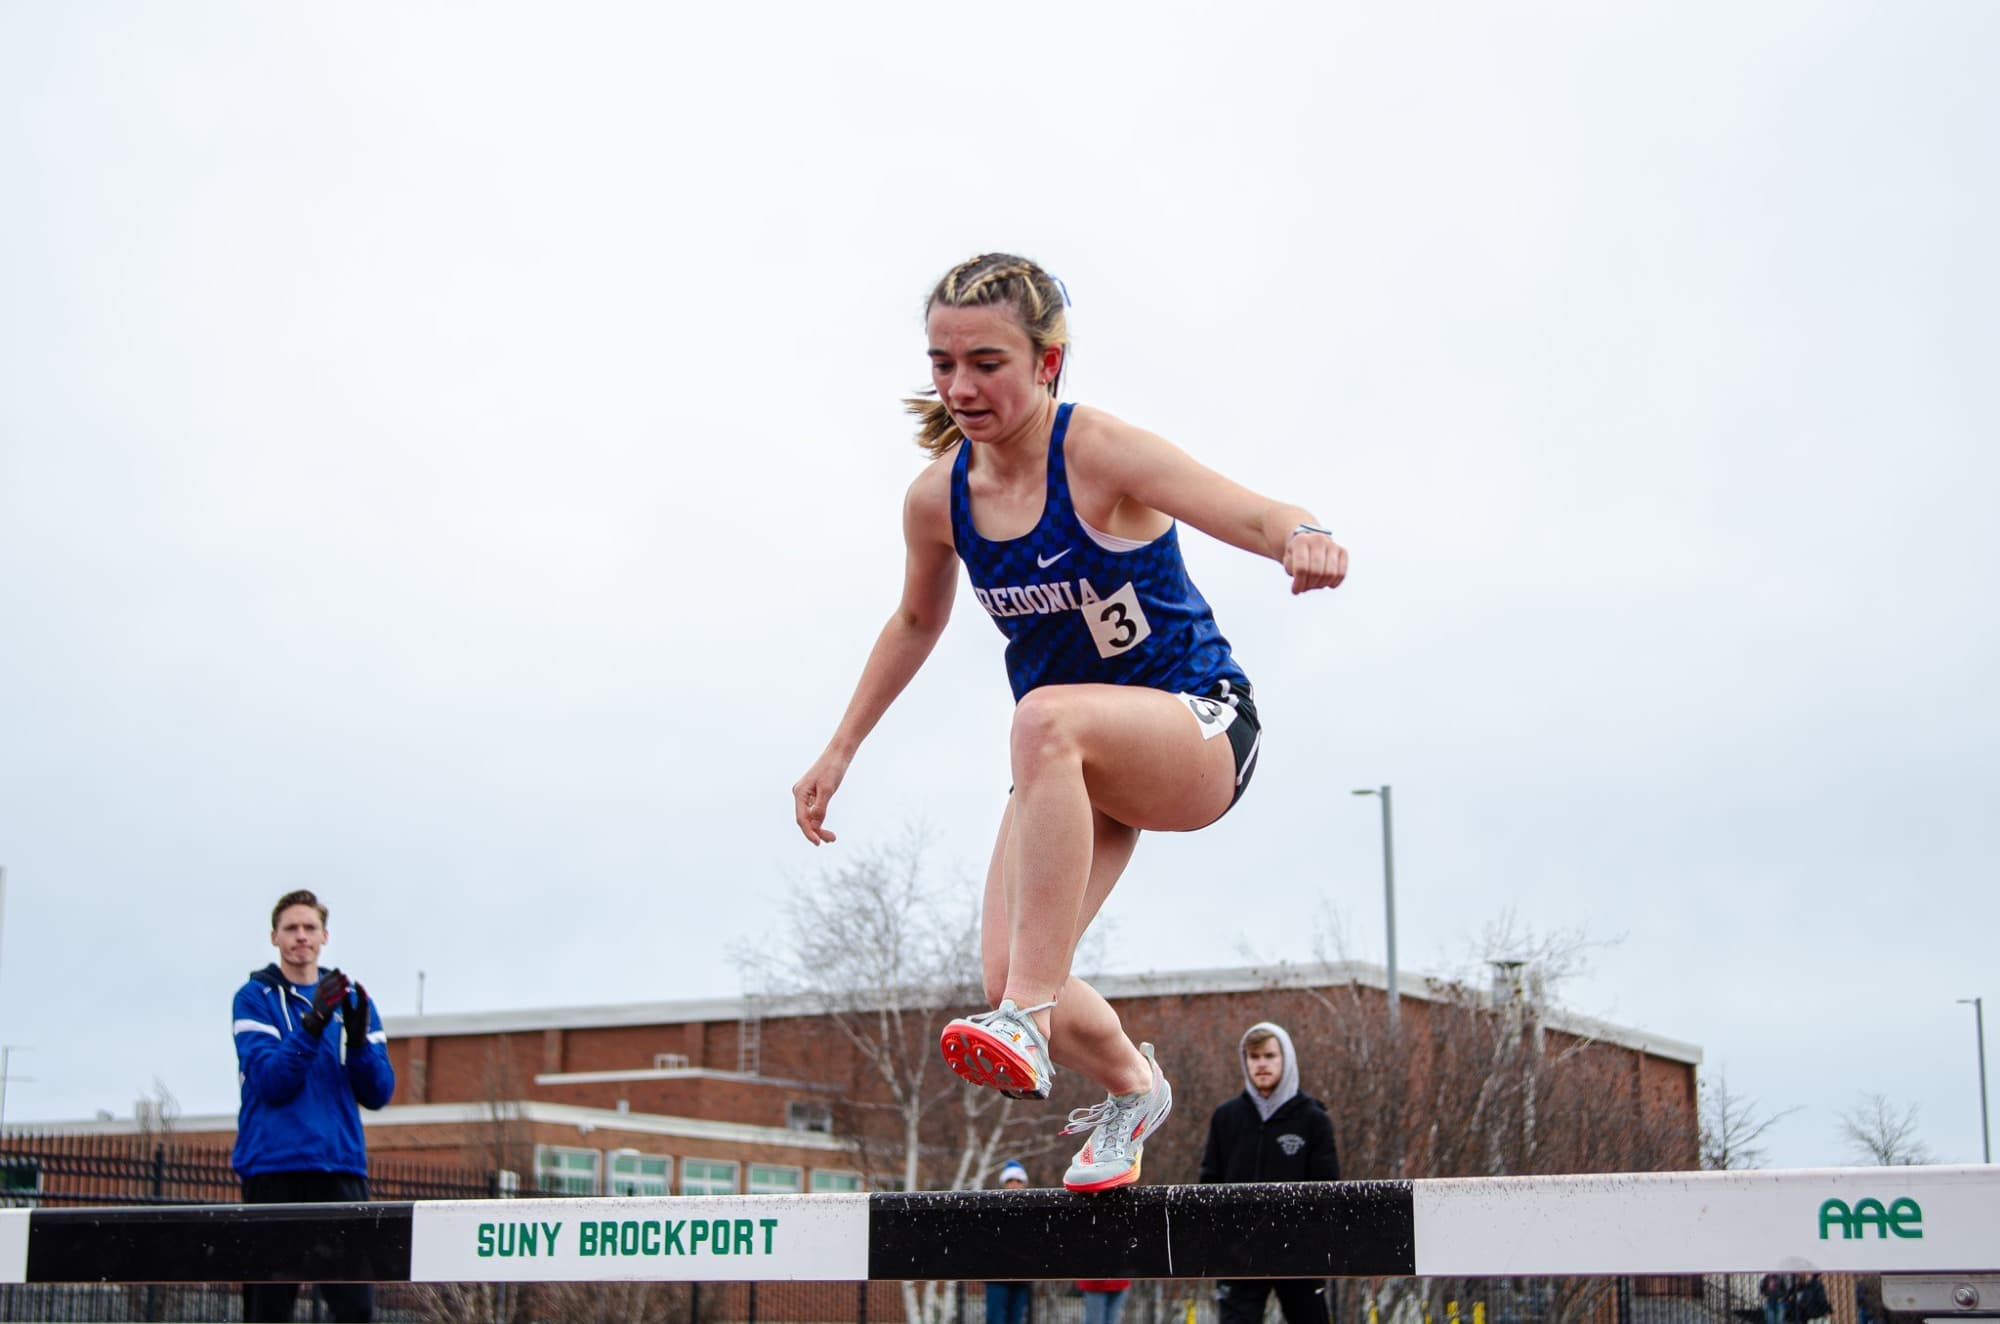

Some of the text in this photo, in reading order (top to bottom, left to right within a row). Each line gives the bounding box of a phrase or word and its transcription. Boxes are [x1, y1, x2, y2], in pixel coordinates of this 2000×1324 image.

[975, 578, 1100, 617] REDONIA
[1100, 602, 1137, 648] 3
[477, 1219, 778, 1257] SUNY BROCKPORT
